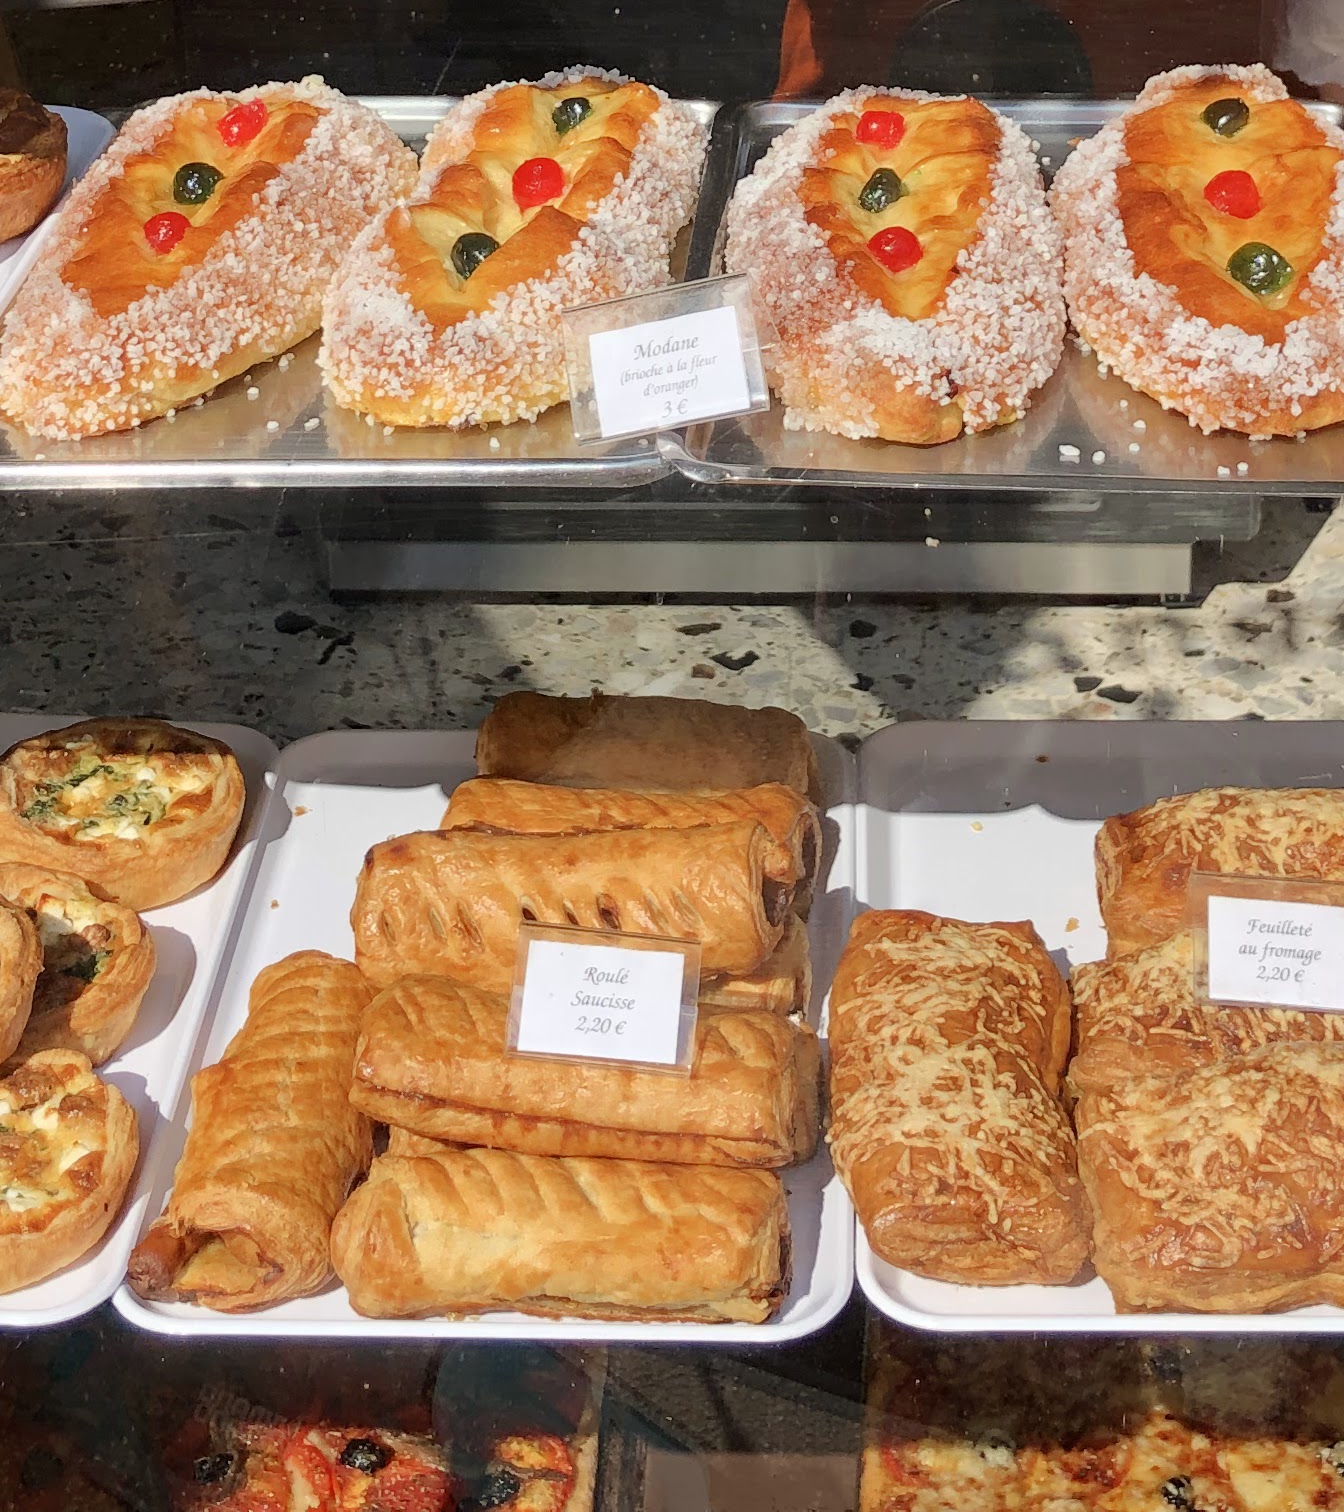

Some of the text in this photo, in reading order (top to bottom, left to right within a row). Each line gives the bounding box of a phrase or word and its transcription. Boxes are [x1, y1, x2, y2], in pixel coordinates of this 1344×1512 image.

[633, 335, 700, 361] Modane
[620, 354, 719, 387] (brioche à la fleur
[643, 375, 699, 397] d'oranger)
[661, 398, 689, 419] 3 €
[1245, 918, 1313, 938] Feuilleté
[1238, 941, 1323, 966] au fromage
[582, 966, 631, 986] Roulé
[1256, 965, 1306, 983] 2,20 €
[570, 990, 636, 1011] Saucisse
[574, 1015, 628, 1036] 2,20 €
